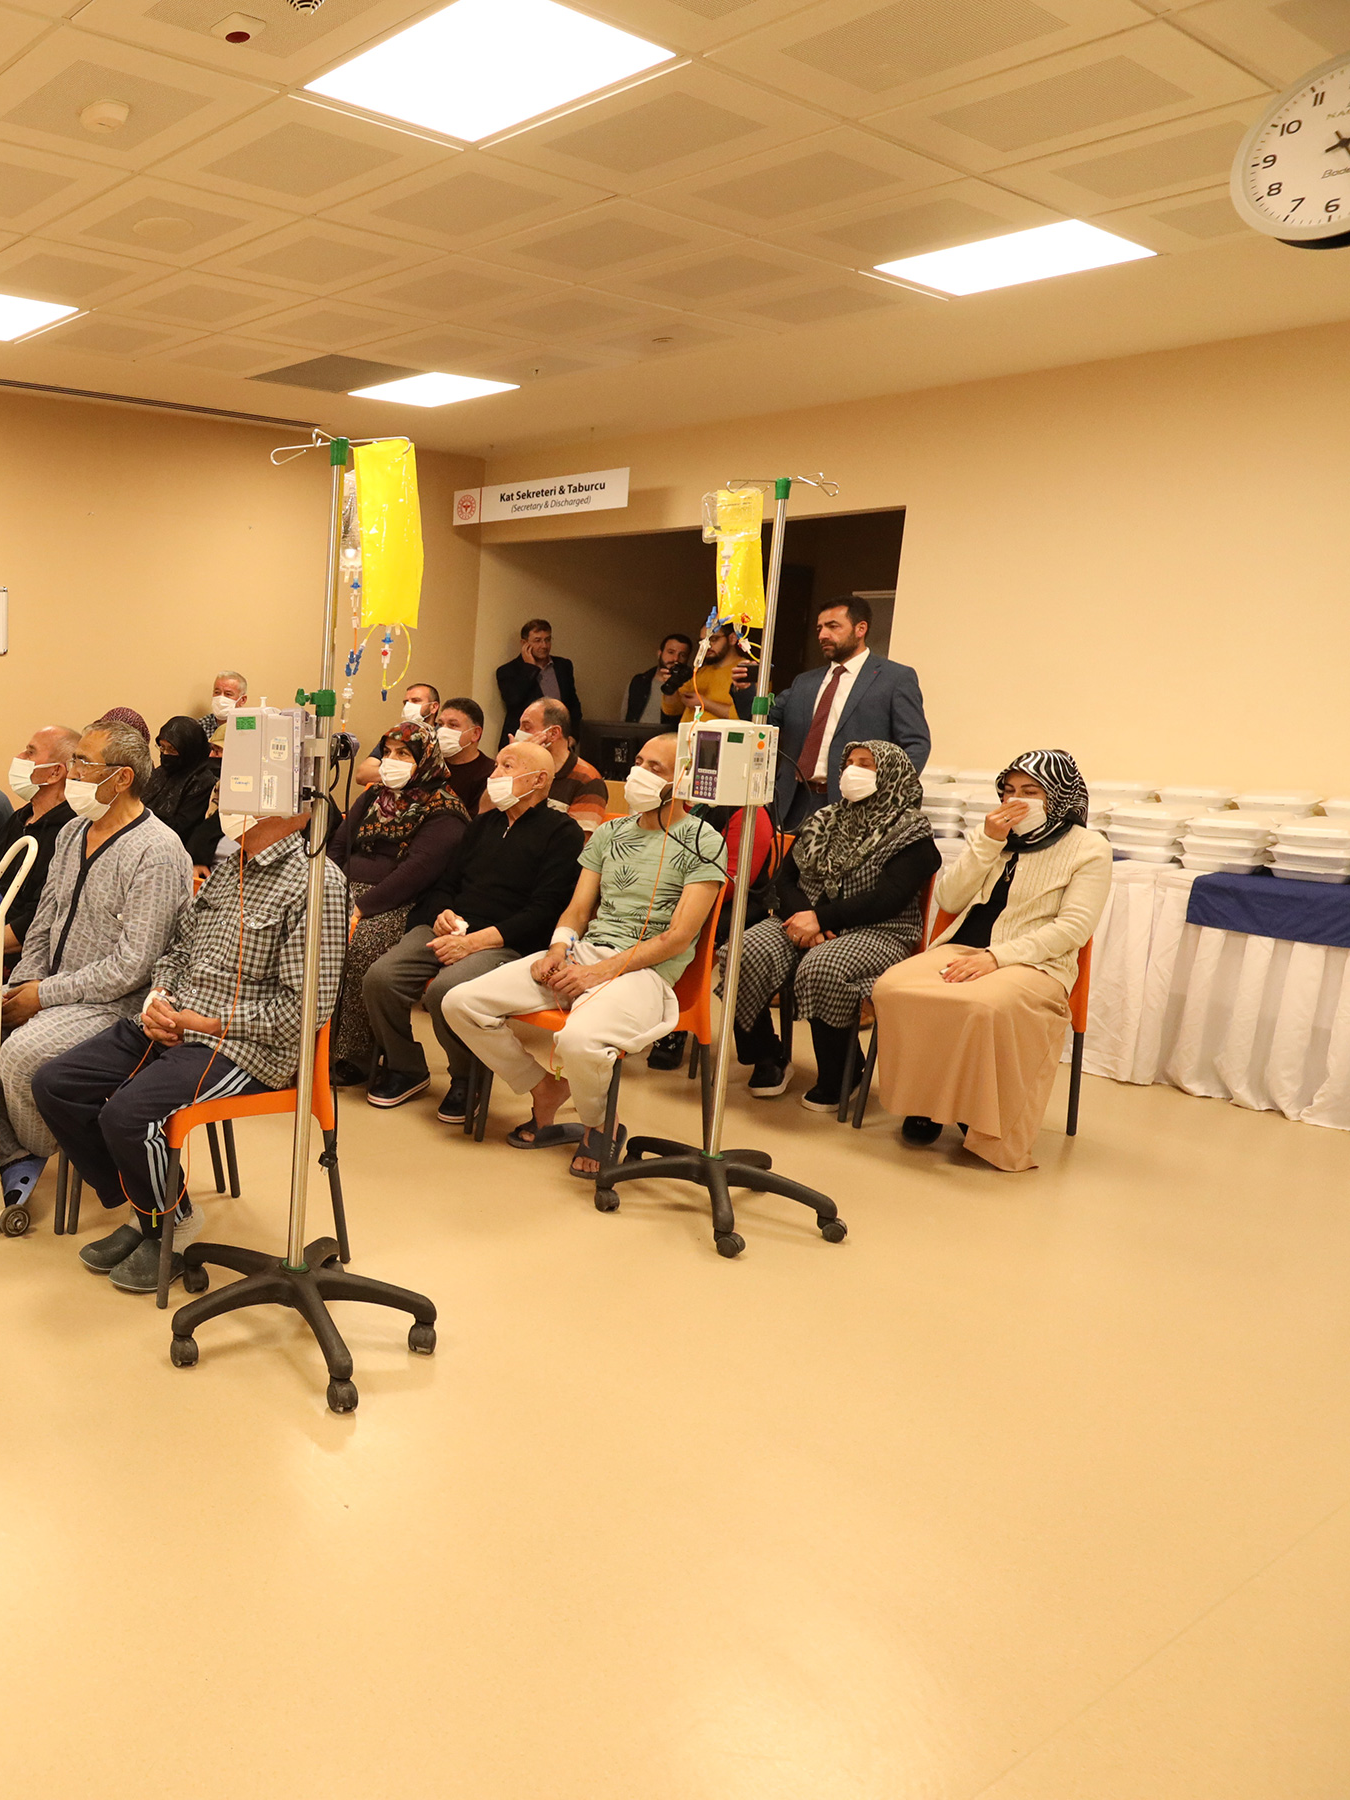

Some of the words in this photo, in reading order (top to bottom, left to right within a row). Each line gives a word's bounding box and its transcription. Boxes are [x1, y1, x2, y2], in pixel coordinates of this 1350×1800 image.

[1313, 91, 1325, 107] 11
[1280, 119, 1302, 136] 10
[1262, 154, 1277, 169] 9
[1267, 182, 1282, 197] 8
[1290, 197, 1305, 213] 7
[1325, 198, 1341, 212] 6
[499, 492, 514, 502] Kat
[515, 486, 556, 501] Sekreteri
[558, 485, 566, 495] &
[567, 482, 606, 494] Taburcu
[511, 502, 543, 513] (Secretary
[543, 500, 550, 509] &
[550, 495, 592, 508] Discharged)
